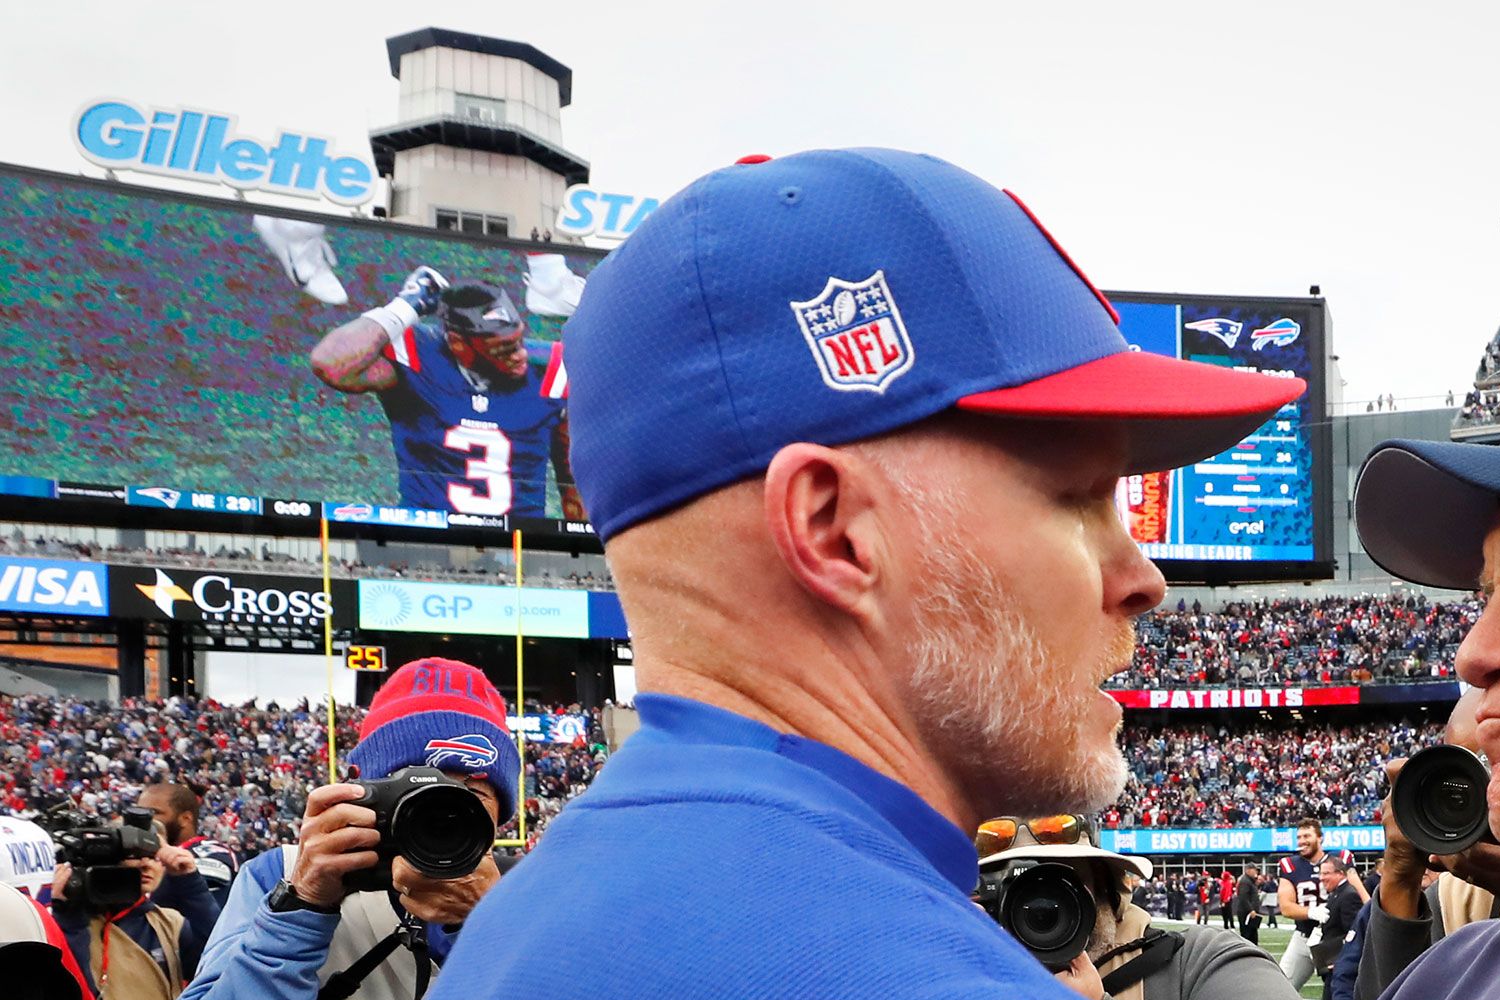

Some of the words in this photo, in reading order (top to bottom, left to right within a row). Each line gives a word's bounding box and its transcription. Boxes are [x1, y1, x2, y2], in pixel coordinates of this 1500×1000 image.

[78, 102, 371, 197] Gillette
[826, 322, 900, 376] NFL
[444, 425, 513, 516] 3
[192, 493, 216, 509] NE
[1229, 520, 1264, 534] enel
[1199, 545, 1252, 560] LEADER
[346, 646, 383, 670] 25
[1150, 688, 1303, 708] PATRIOTS
[409, 775, 438, 784] Canon
[1151, 833, 1187, 850] EASY
[1188, 832, 1208, 849] TO
[1209, 831, 1254, 849] ENJOY
[1352, 829, 1371, 847] TO
